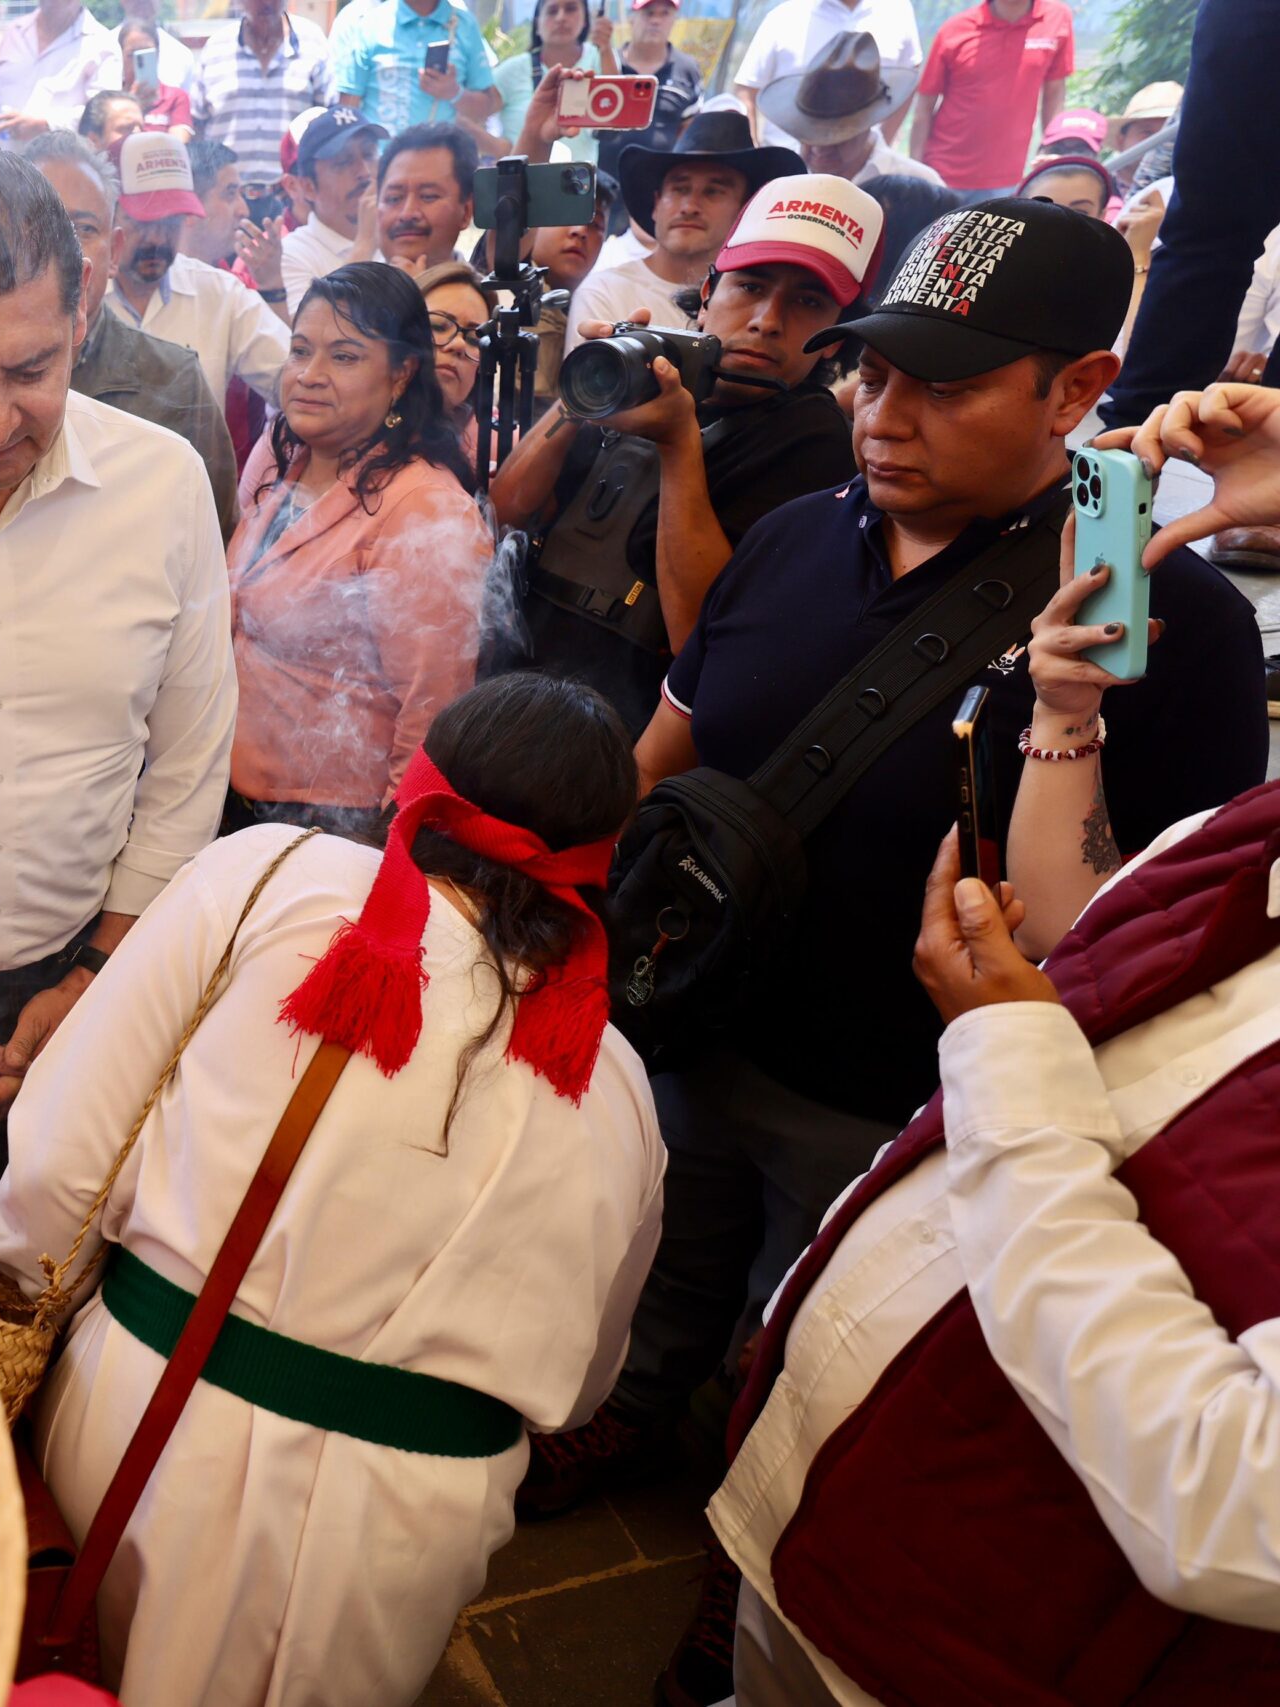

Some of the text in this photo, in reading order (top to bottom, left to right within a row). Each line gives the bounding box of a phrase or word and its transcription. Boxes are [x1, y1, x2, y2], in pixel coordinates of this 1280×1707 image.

[768, 200, 864, 244] ARMENTA
[787, 213, 846, 238] GOBERNADOR
[898, 259, 987, 288] ARMENTA
[907, 245, 996, 275] ARMENTA
[881, 286, 970, 316] ARMENTA
[889, 272, 978, 303] ARMENTA
[688, 864, 725, 904] KAMPAK
